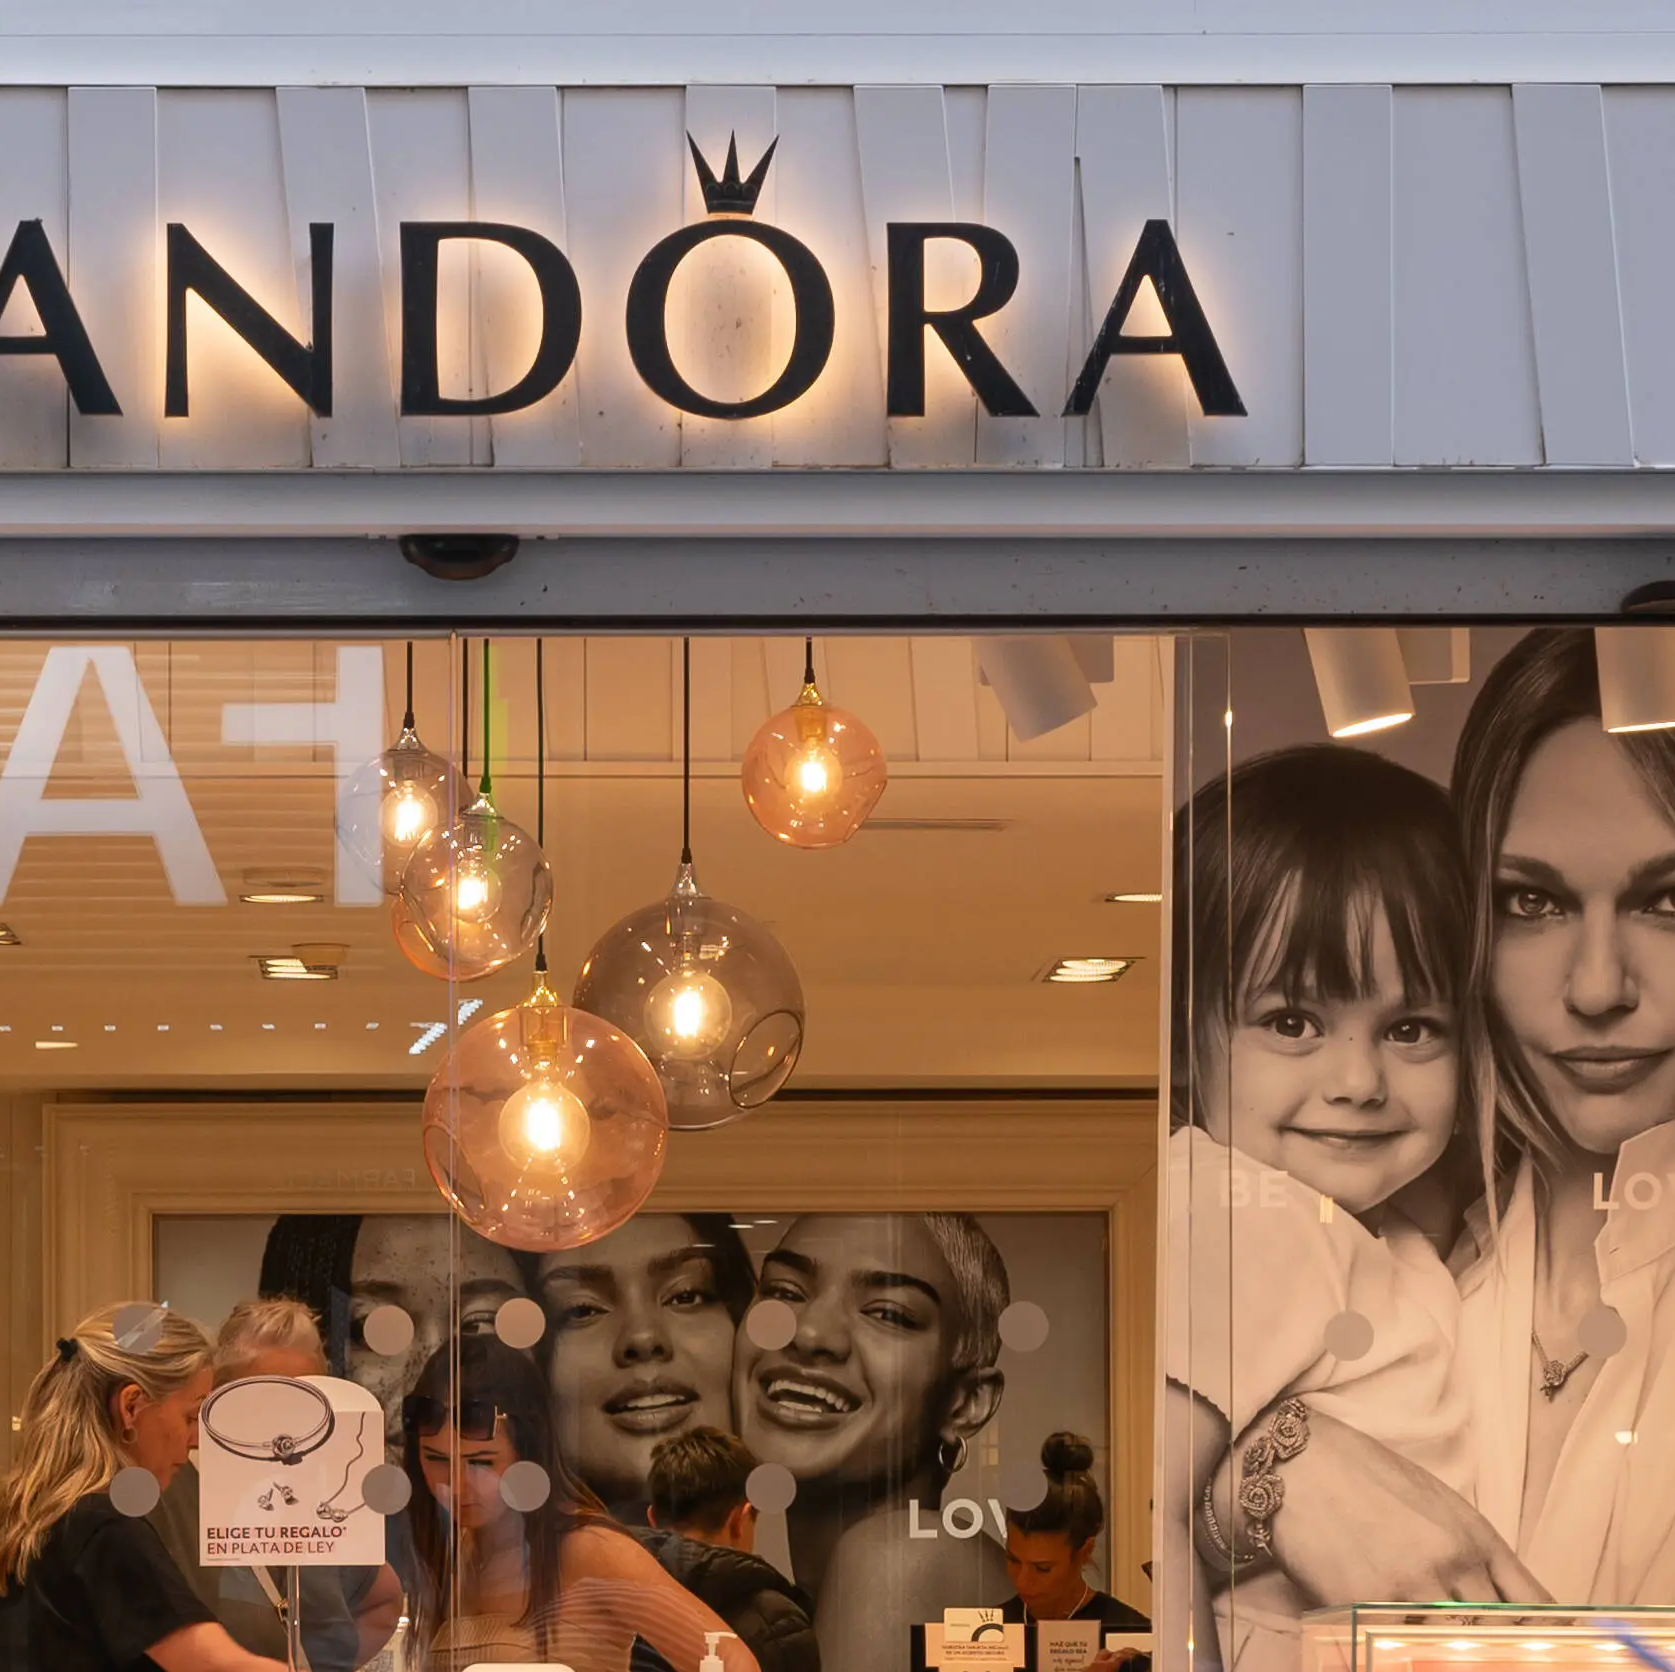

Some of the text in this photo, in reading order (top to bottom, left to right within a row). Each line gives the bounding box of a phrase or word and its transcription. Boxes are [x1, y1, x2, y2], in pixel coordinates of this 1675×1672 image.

[1220, 1170, 1289, 1209] BE
[909, 1498, 1007, 1539] LOV
[207, 1527, 250, 1539] ELIGE
[255, 1527, 275, 1538] TU
[207, 1541, 335, 1555] EN PLATA DE LEY
